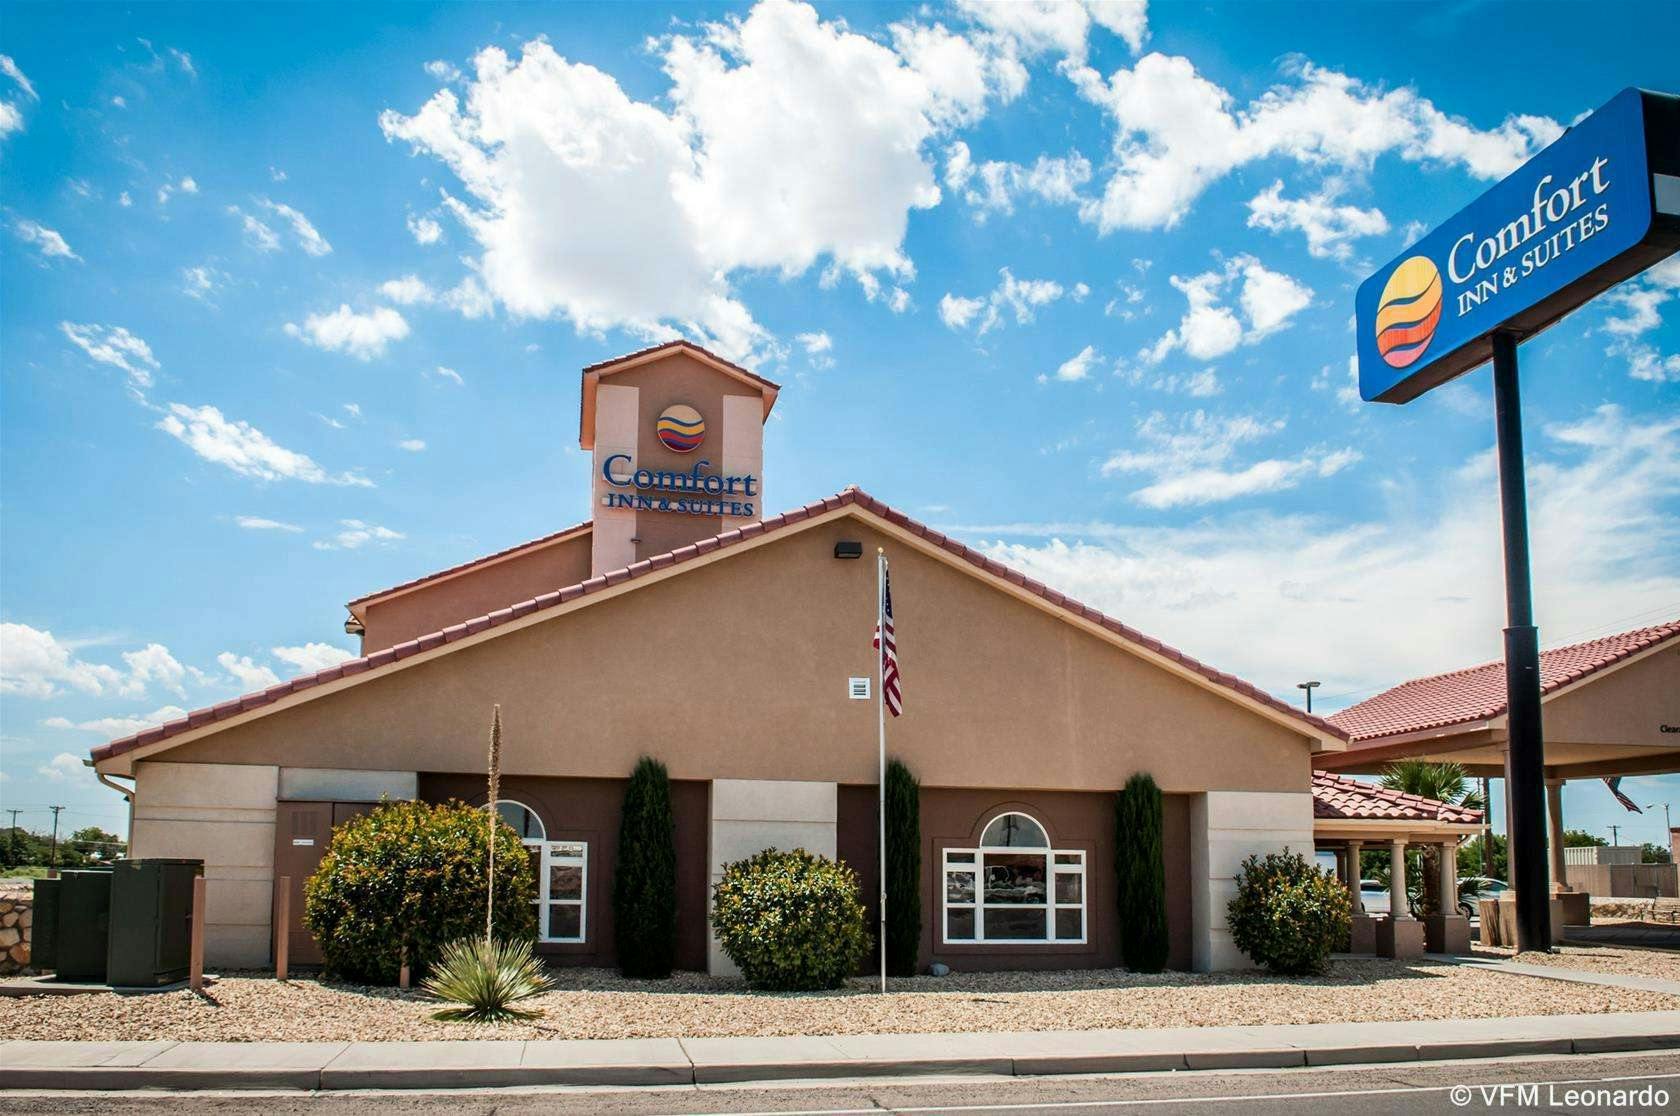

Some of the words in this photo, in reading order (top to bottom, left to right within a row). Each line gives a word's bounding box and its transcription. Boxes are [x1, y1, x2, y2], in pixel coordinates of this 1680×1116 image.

[1448, 155, 1611, 285] Comfort
[1457, 272, 1499, 317] INN
[1502, 266, 1518, 289] &
[1521, 203, 1609, 277] SUITES
[602, 454, 758, 497] Comfort
[607, 493, 654, 511] INN
[658, 497, 672, 512] &
[677, 499, 754, 517] SUITES
